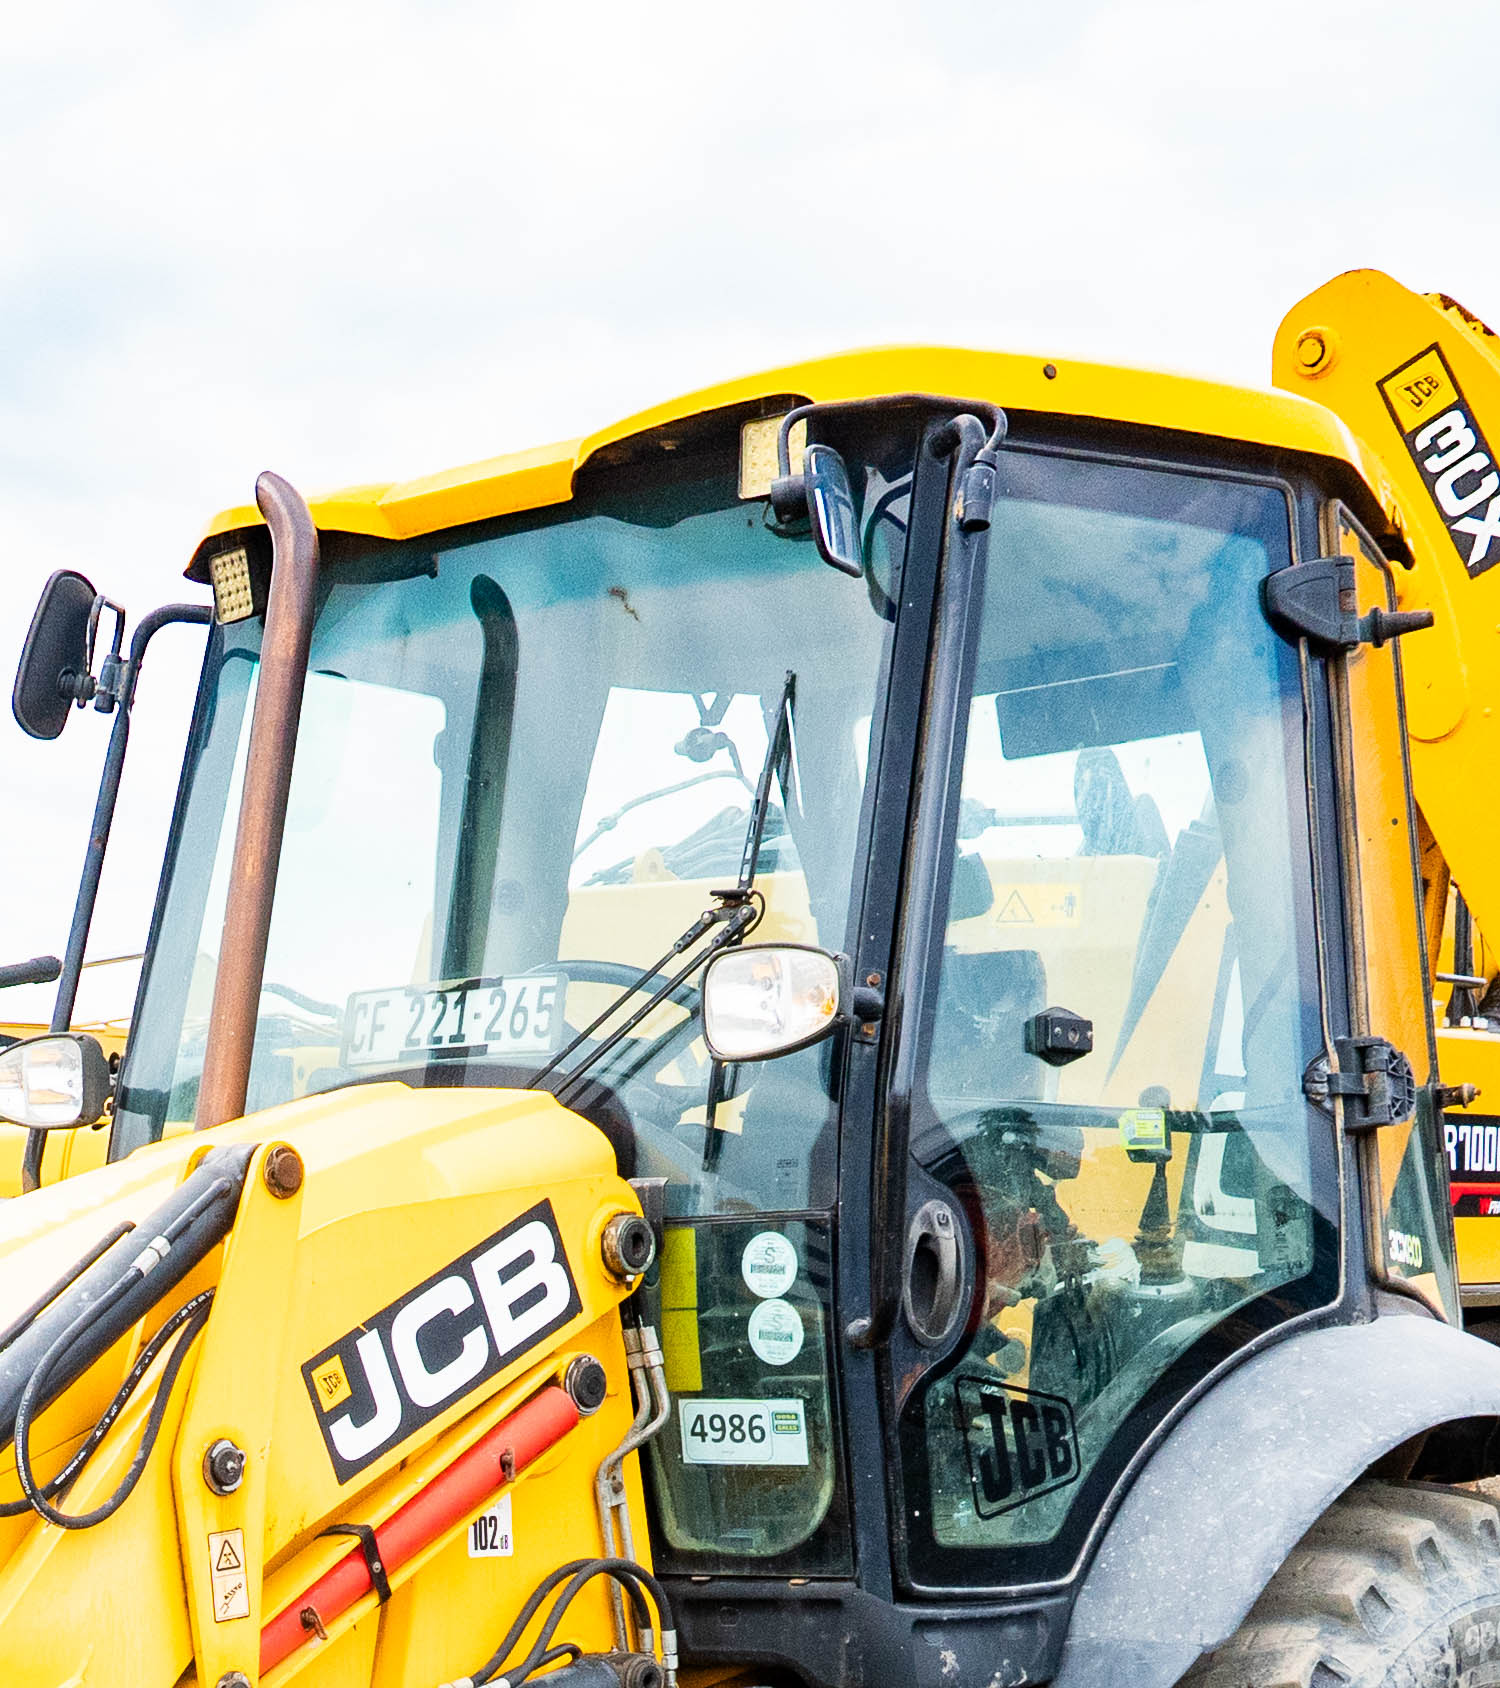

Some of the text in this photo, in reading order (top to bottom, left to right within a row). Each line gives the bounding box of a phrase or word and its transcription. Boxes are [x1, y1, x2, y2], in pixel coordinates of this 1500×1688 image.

[1403, 376, 1440, 408] JCB
[350, 985, 557, 1053] CF 221-265
[328, 1219, 572, 1462] JCB
[322, 1372, 342, 1395] JCB
[690, 1413, 766, 1444] 4986
[980, 1390, 1073, 1503] JCB
[472, 1515, 499, 1551] 102
